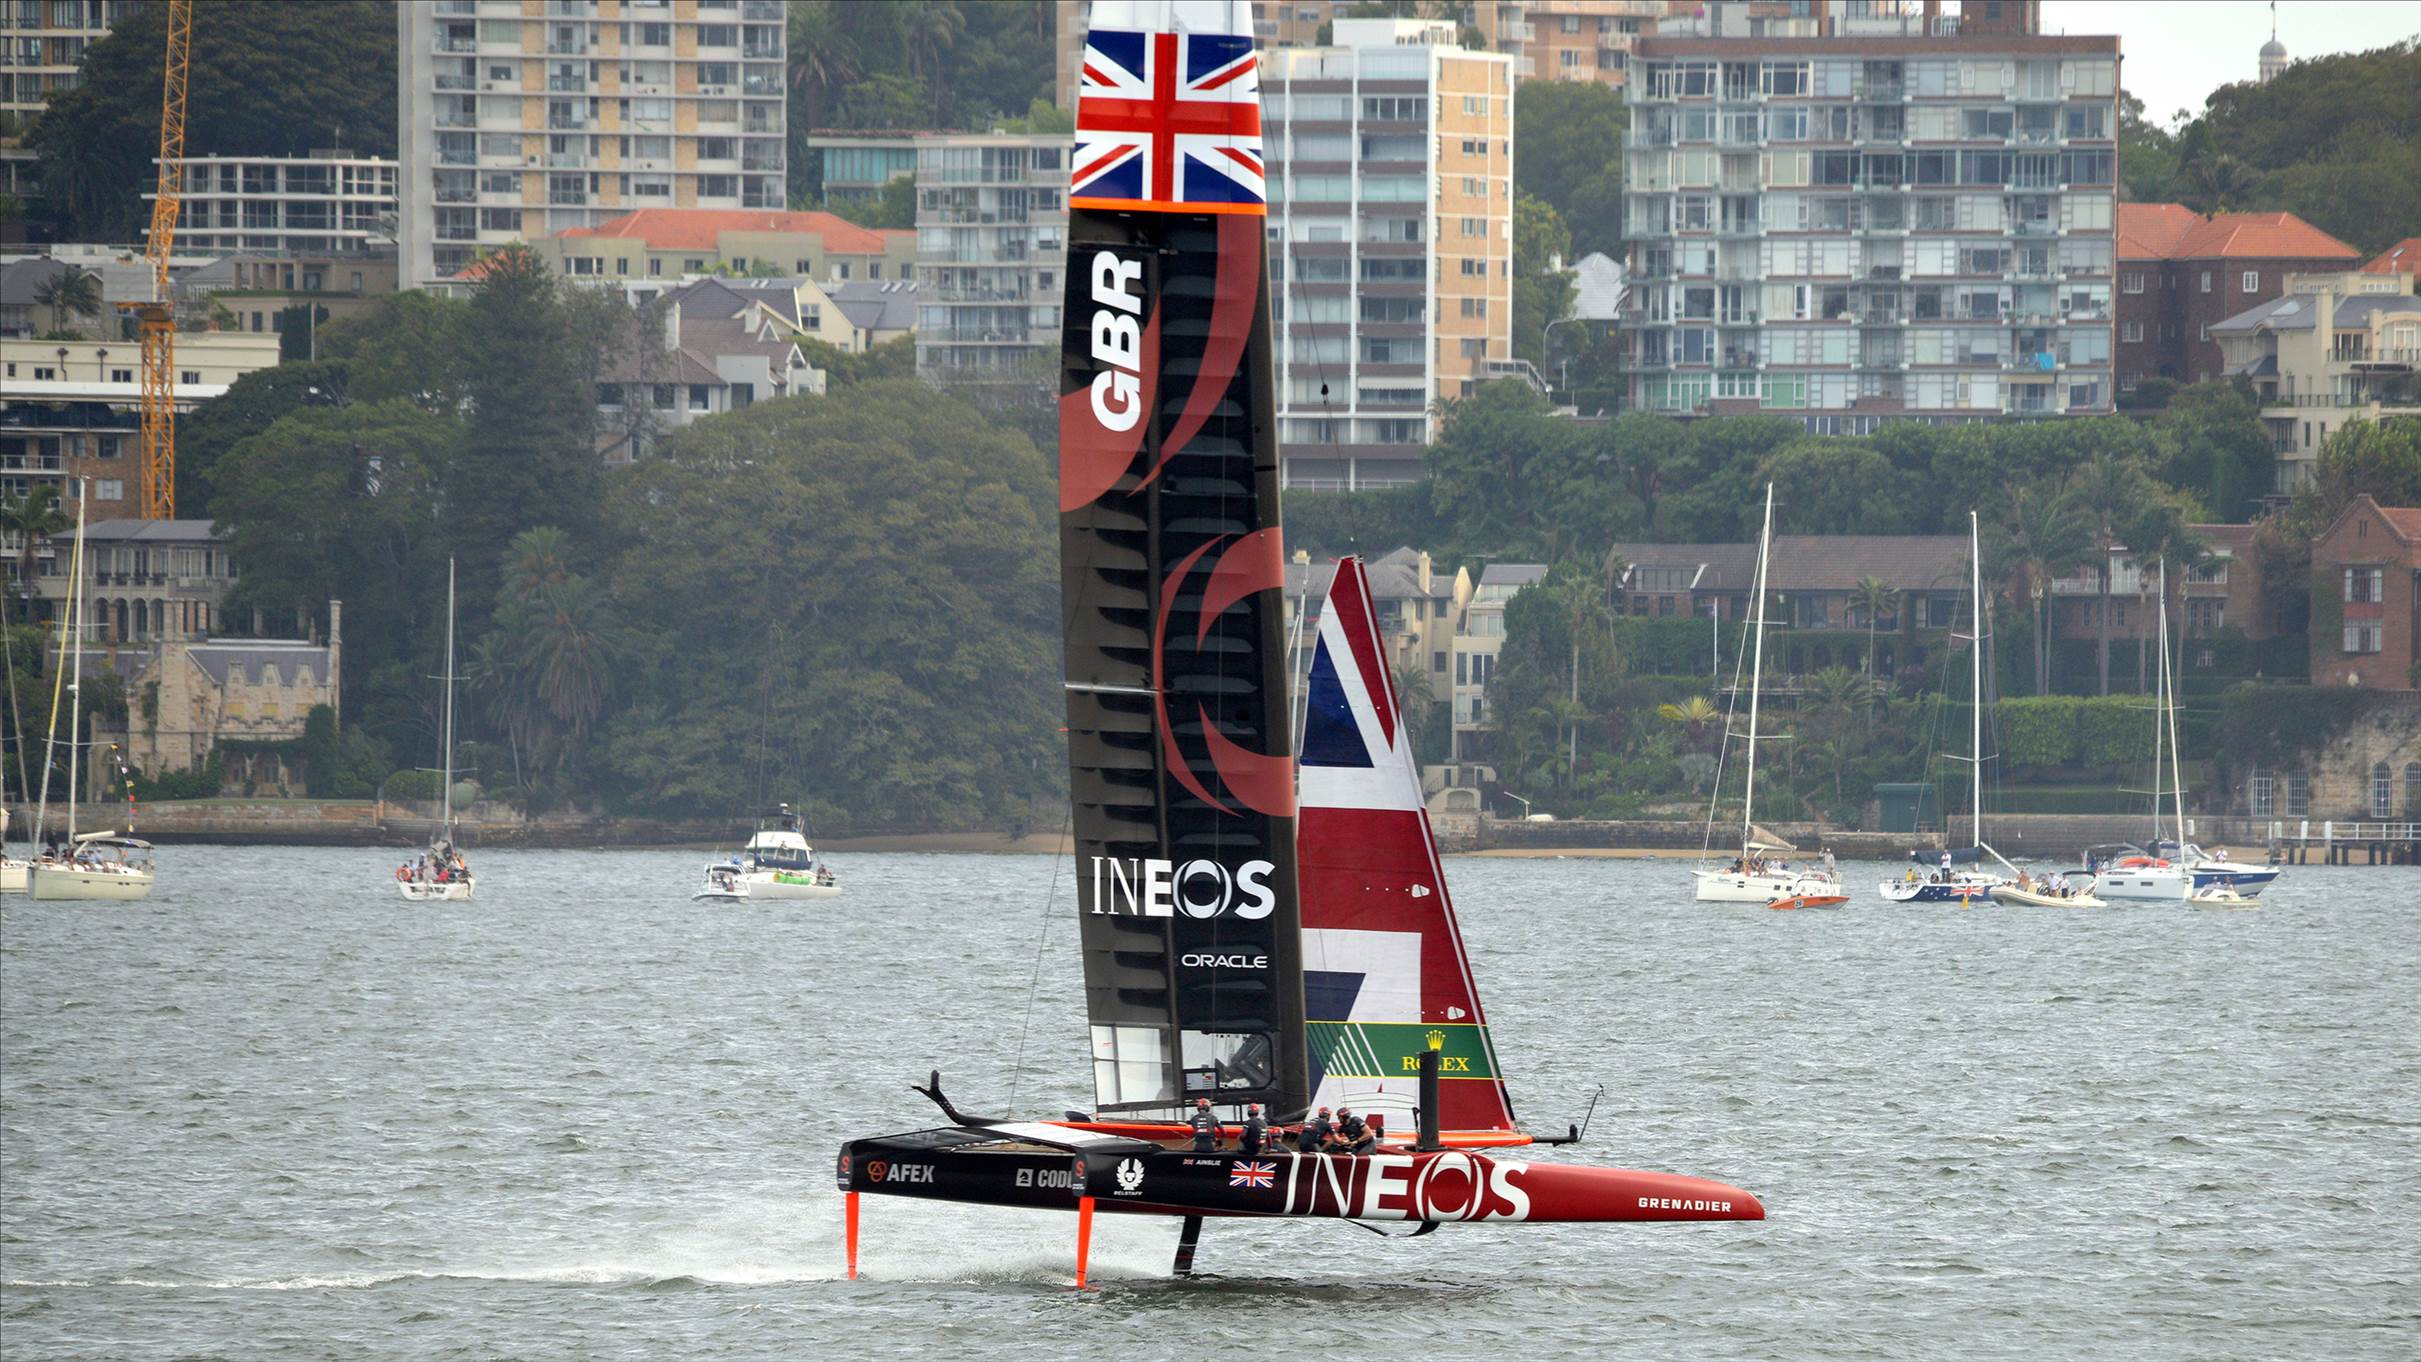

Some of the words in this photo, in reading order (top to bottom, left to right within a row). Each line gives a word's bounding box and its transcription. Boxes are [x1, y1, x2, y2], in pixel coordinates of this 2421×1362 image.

[1090, 250, 1142, 432] GBR
[1090, 856, 1276, 920] INEOS
[1181, 953, 1268, 969] ORACLE
[1402, 1056, 1470, 1071] REX
[886, 1163, 935, 1183] AFEX
[1282, 1151, 1531, 1222] INEOS
[1638, 1196, 1732, 1213] GRENADIER
